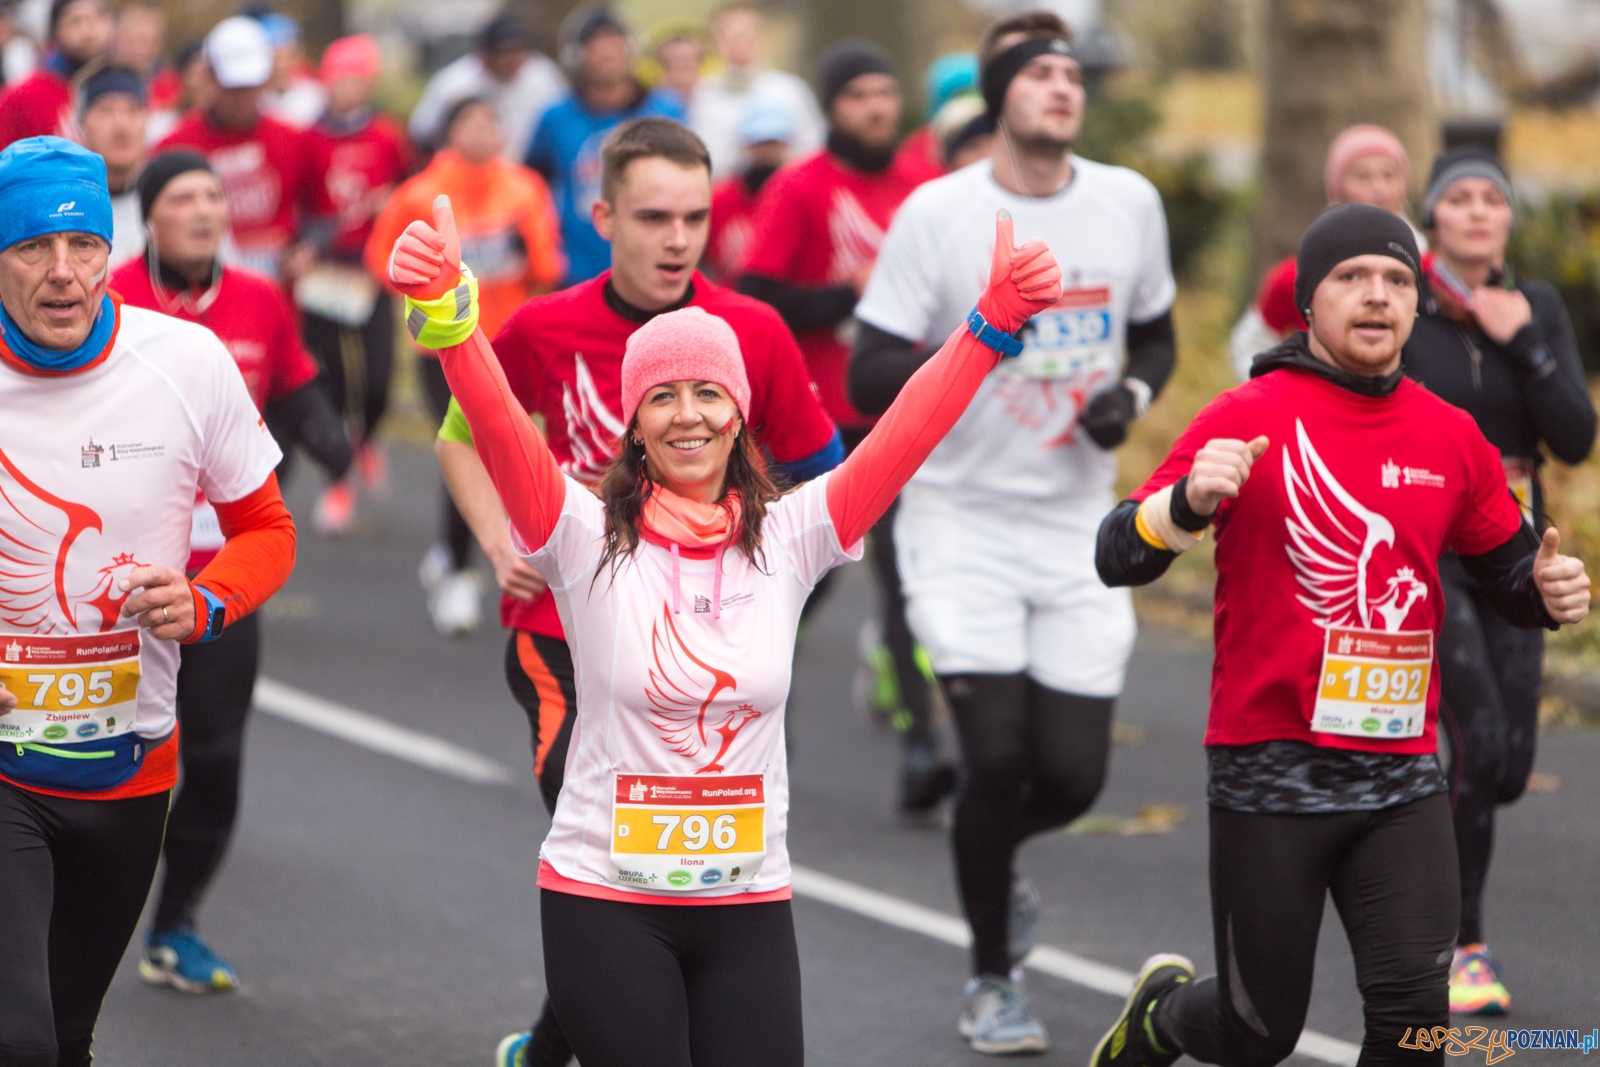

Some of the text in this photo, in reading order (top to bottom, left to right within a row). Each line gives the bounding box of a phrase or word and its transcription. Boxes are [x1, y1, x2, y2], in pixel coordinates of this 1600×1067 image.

[109, 444, 119, 461] 1
[25, 645, 33, 659] 1
[76, 643, 133, 656] RunPoland.org
[27, 670, 114, 707] 795
[1325, 665, 1423, 702] D 1992
[46, 713, 91, 722] Zbigniew
[0, 723, 21, 731] RUPA
[650, 785, 658, 799] 1
[702, 788, 757, 797] RunPoland.org
[618, 814, 737, 851] D 796
[680, 858, 705, 866] Ilona
[618, 869, 644, 878] GRUPA
[618, 875, 648, 884] LUXMED
